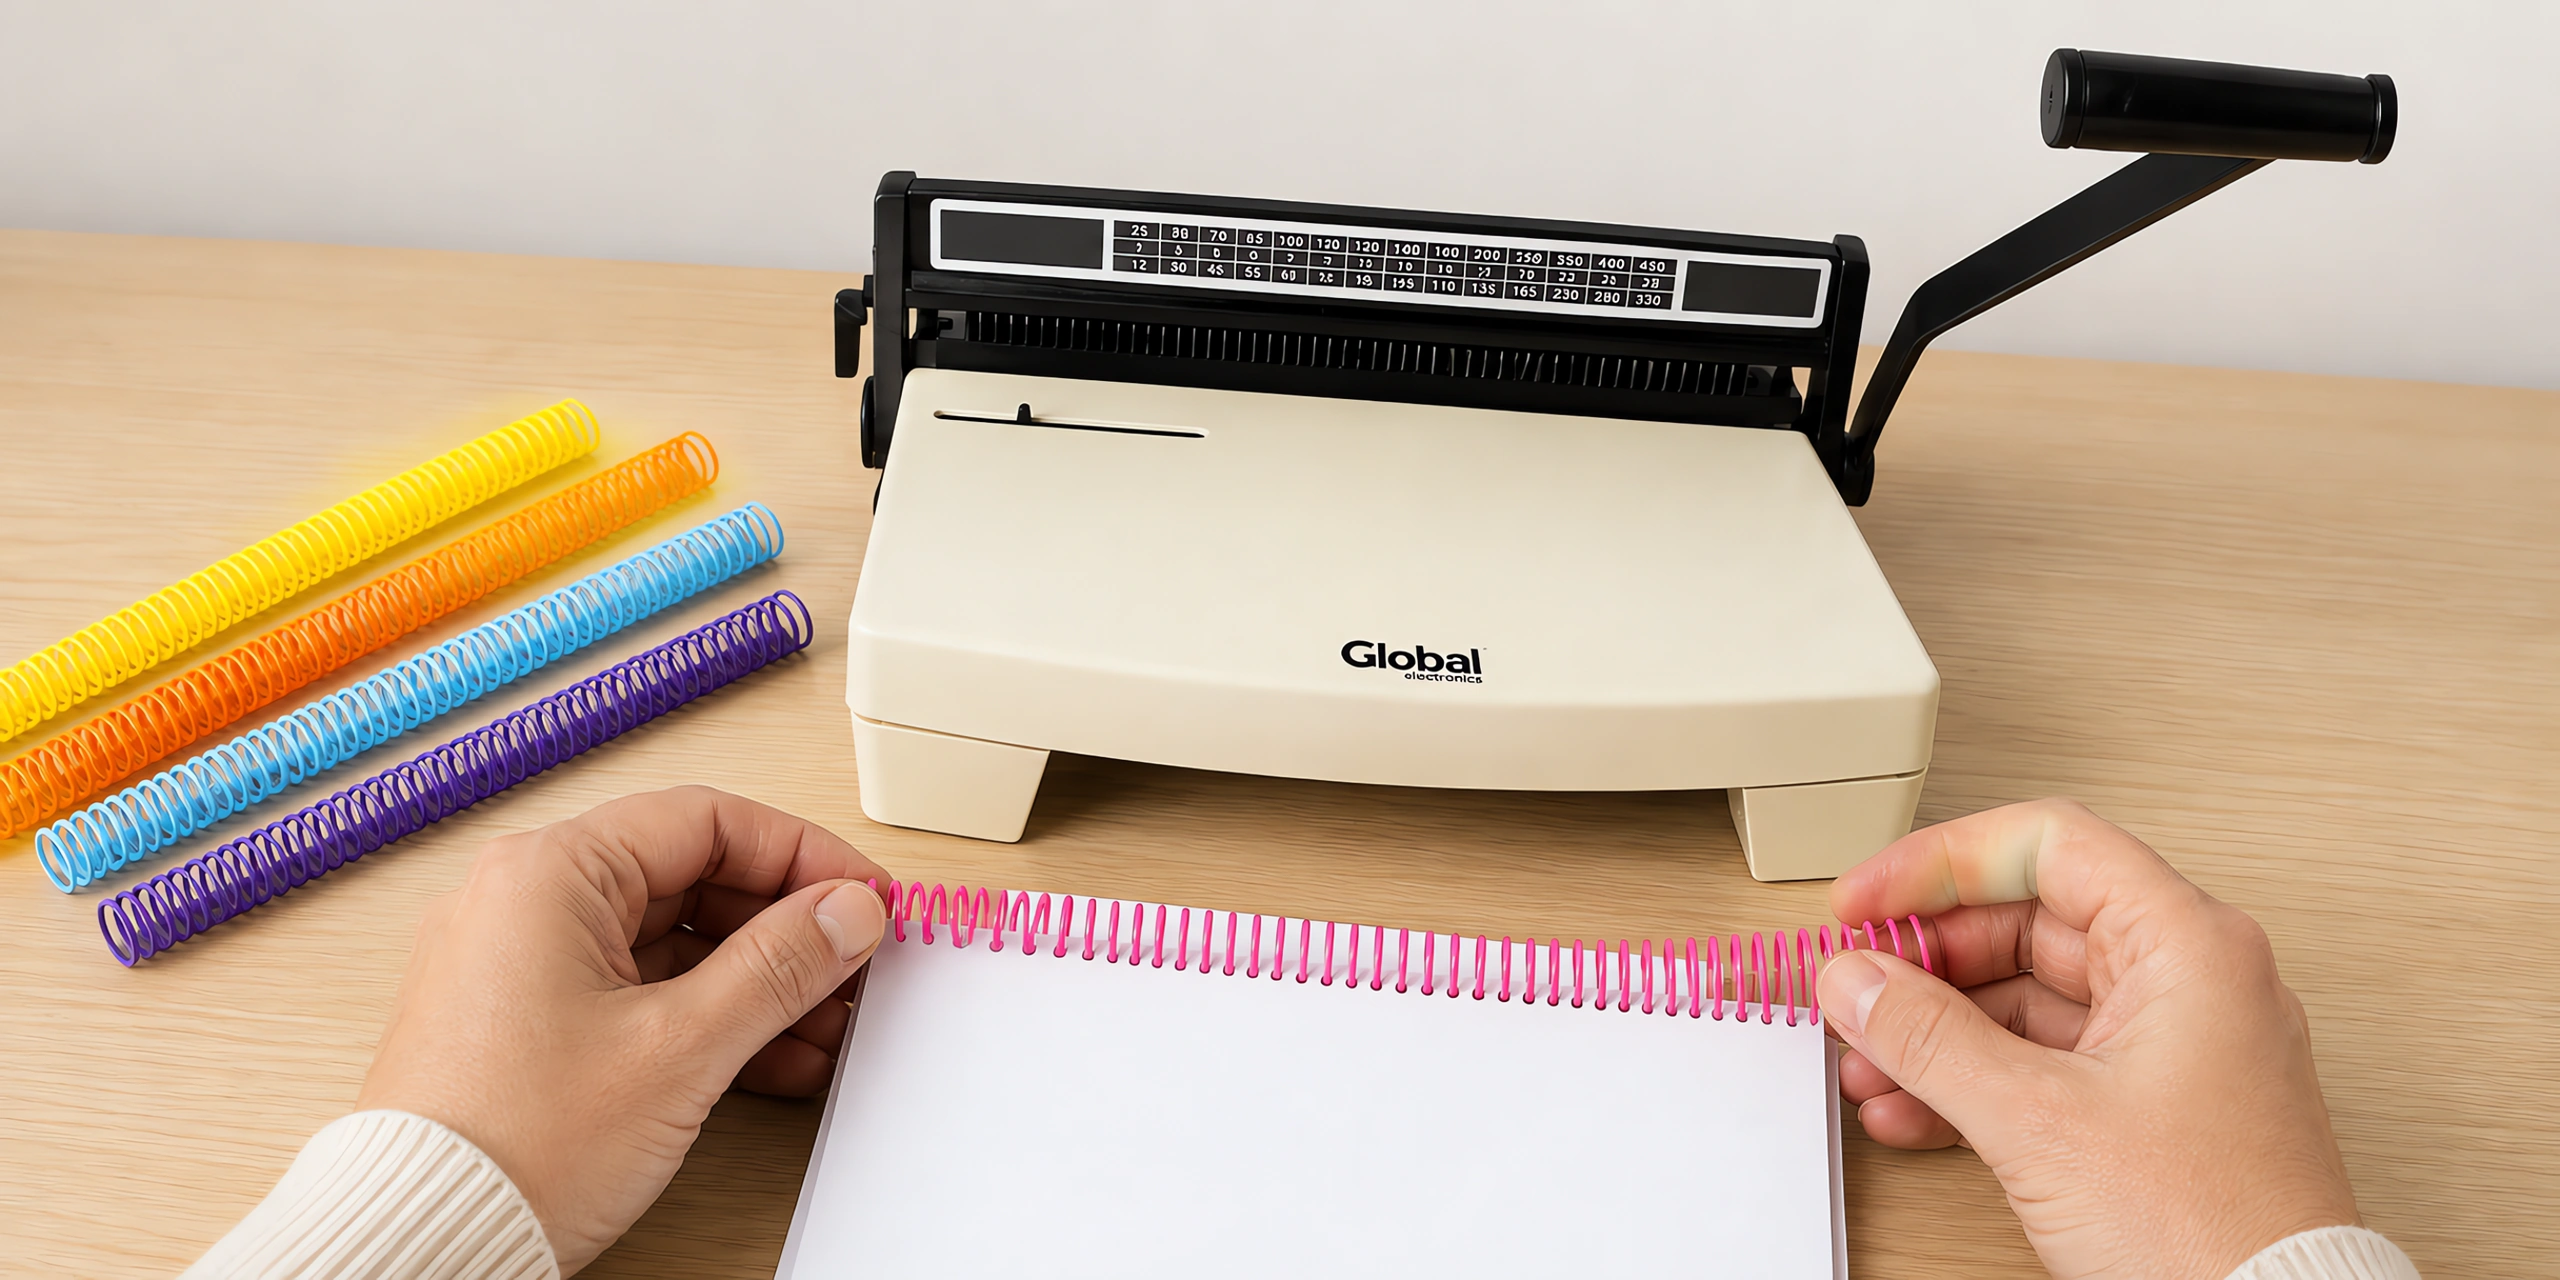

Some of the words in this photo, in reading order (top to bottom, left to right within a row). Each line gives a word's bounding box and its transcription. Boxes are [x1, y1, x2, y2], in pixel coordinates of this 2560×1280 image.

[1209, 229, 1228, 242] 70
[1435, 246, 1460, 259] 100
[1132, 259, 1147, 271] 12
[1432, 279, 1456, 292] 110
[1635, 294, 1661, 306] 330
[1341, 640, 1482, 675] Global
